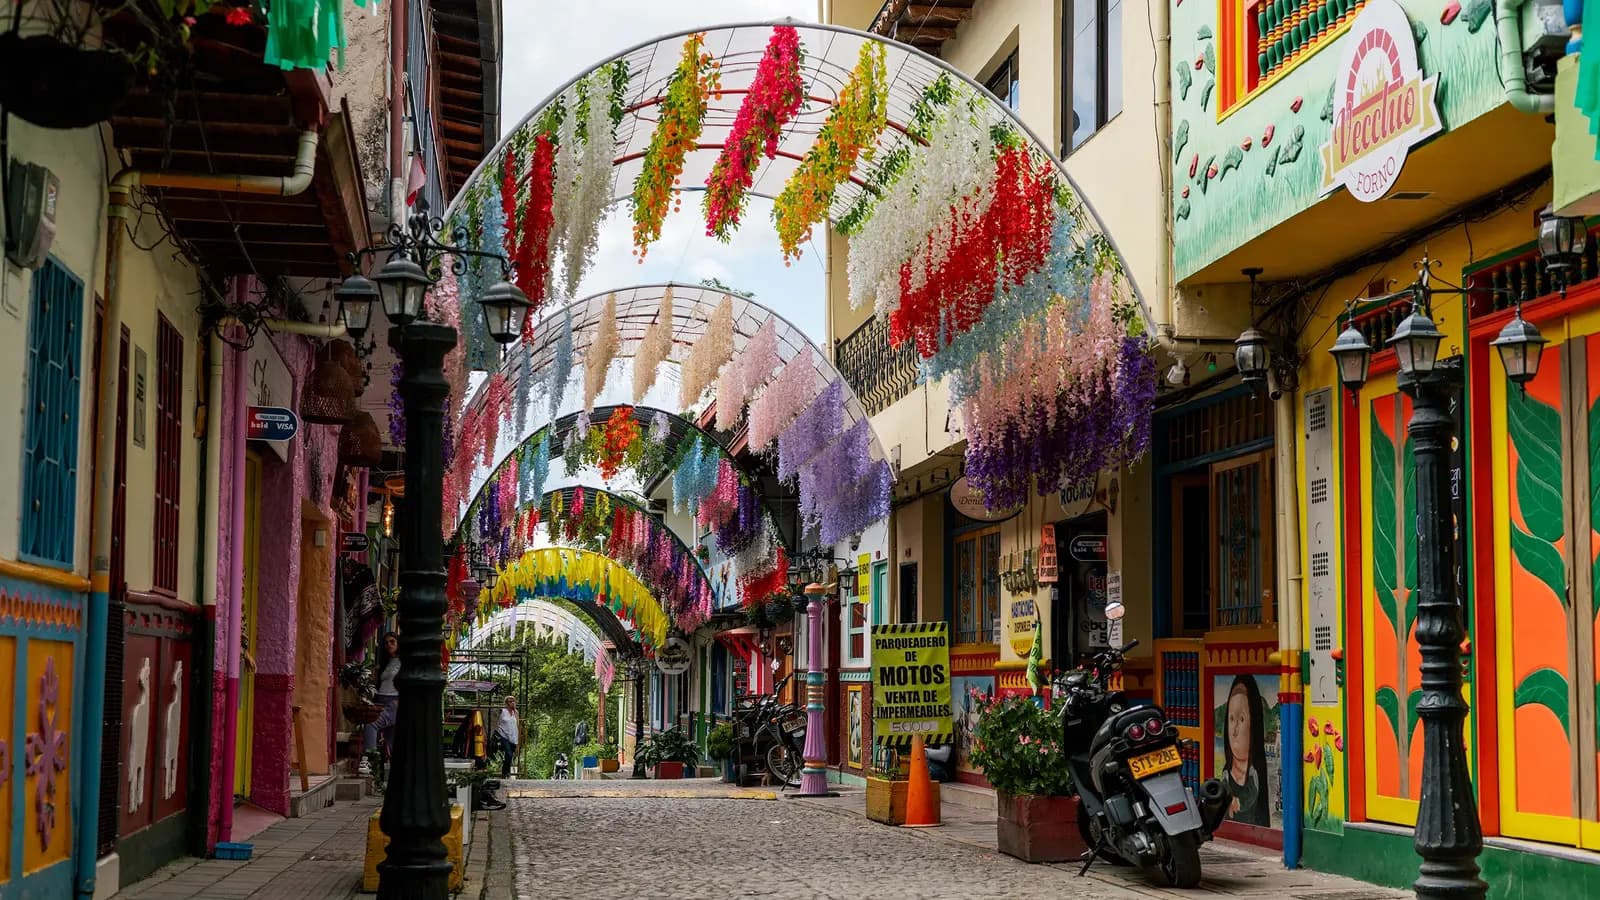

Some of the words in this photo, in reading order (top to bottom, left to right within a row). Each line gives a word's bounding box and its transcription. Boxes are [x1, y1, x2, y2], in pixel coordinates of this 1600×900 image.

[1334, 81, 1415, 163] Vecchio
[1356, 156, 1396, 194] FORNO
[276, 422, 294, 430] VISA
[876, 636, 946, 650] PARQUEADERO
[905, 651, 918, 662] DE
[880, 664, 945, 686] MOTOS
[885, 691, 920, 704] VENTA
[923, 690, 938, 702] DE
